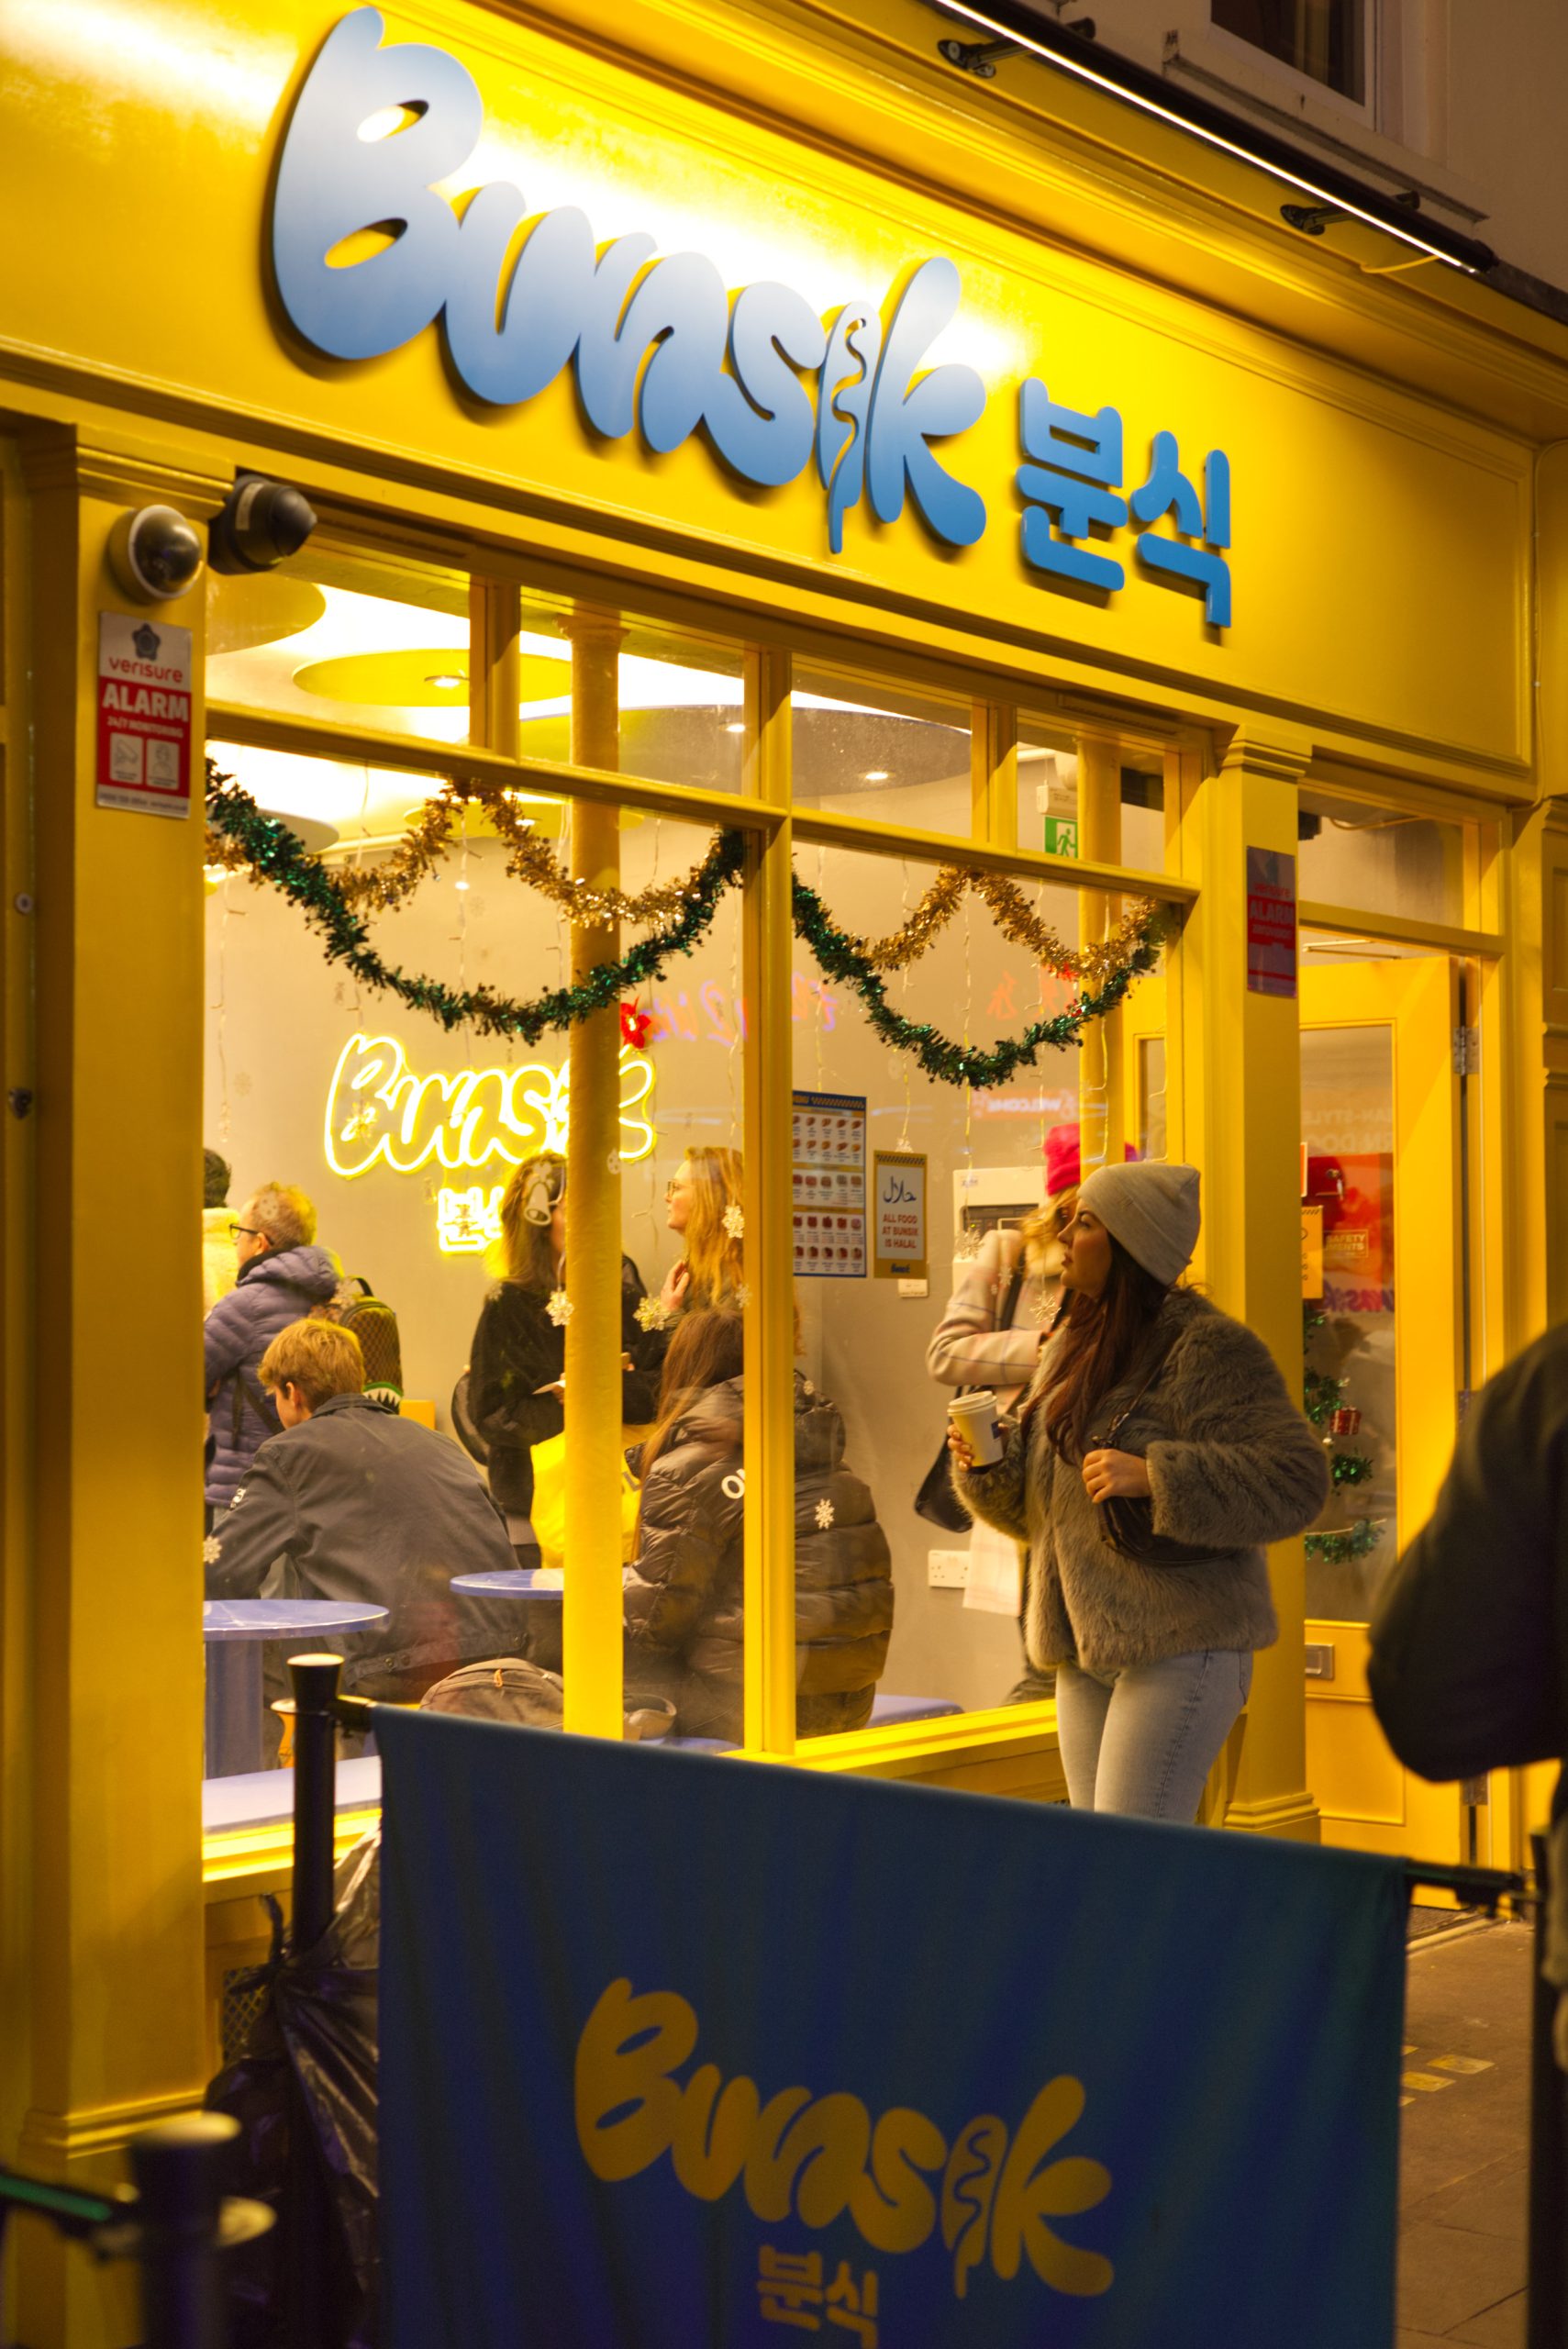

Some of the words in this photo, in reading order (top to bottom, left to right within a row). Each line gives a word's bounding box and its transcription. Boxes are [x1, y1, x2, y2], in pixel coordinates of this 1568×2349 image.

[272, 6, 987, 555] Bunsik
[1016, 376, 1232, 629] 분식
[108, 655, 183, 684] verisure
[102, 683, 189, 723] ALARM
[1250, 899, 1296, 926] ALARM
[883, 1175, 917, 1204] حلال
[883, 1213, 897, 1224] ALL
[897, 1214, 918, 1225] FOOD
[893, 1238, 917, 1249] HALAL
[1326, 1233, 1366, 1243] SAFETY
[573, 1976, 1115, 2299] Bunsik
[756, 2243, 878, 2349] 분식
